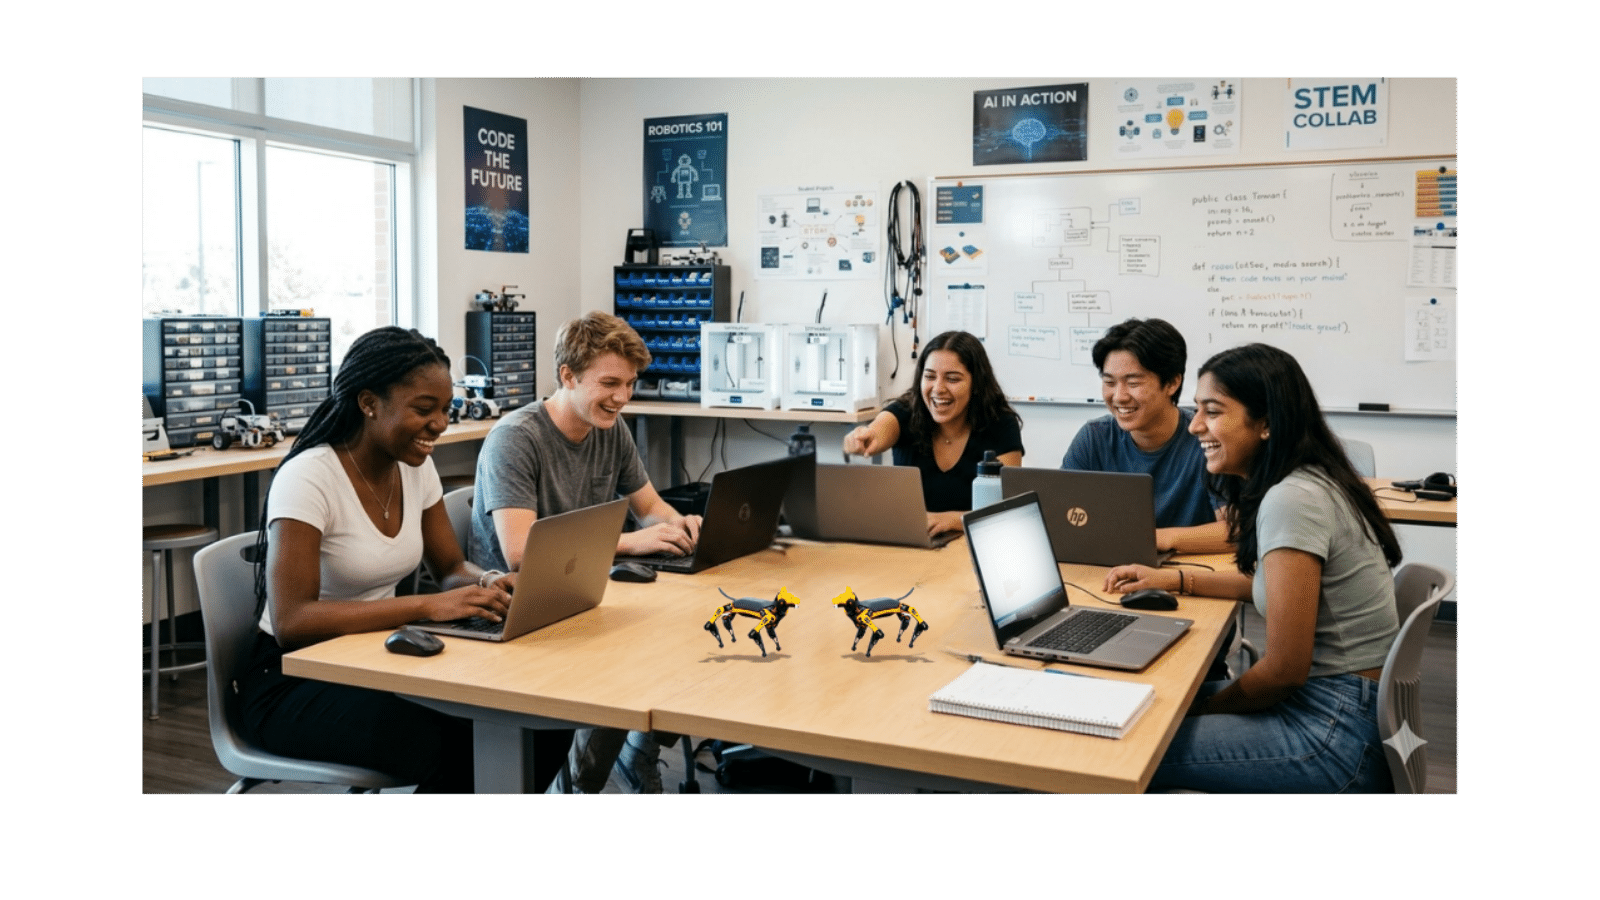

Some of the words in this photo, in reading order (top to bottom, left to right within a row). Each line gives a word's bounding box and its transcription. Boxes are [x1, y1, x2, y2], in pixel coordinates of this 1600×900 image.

[983, 96, 998, 109] AI
[1002, 94, 1017, 107] IN
[1020, 90, 1077, 106] ACTION
[1294, 83, 1377, 110] STEM
[648, 122, 703, 136] ROBOTICS
[706, 120, 723, 132] 101
[1293, 109, 1377, 129] COLLAB
[478, 128, 515, 150] CODE
[484, 150, 510, 170] THE
[471, 168, 523, 192] FUTURE
[1192, 194, 1218, 205] public
[1192, 262, 1205, 270] def
[1070, 507, 1086, 526] hp
